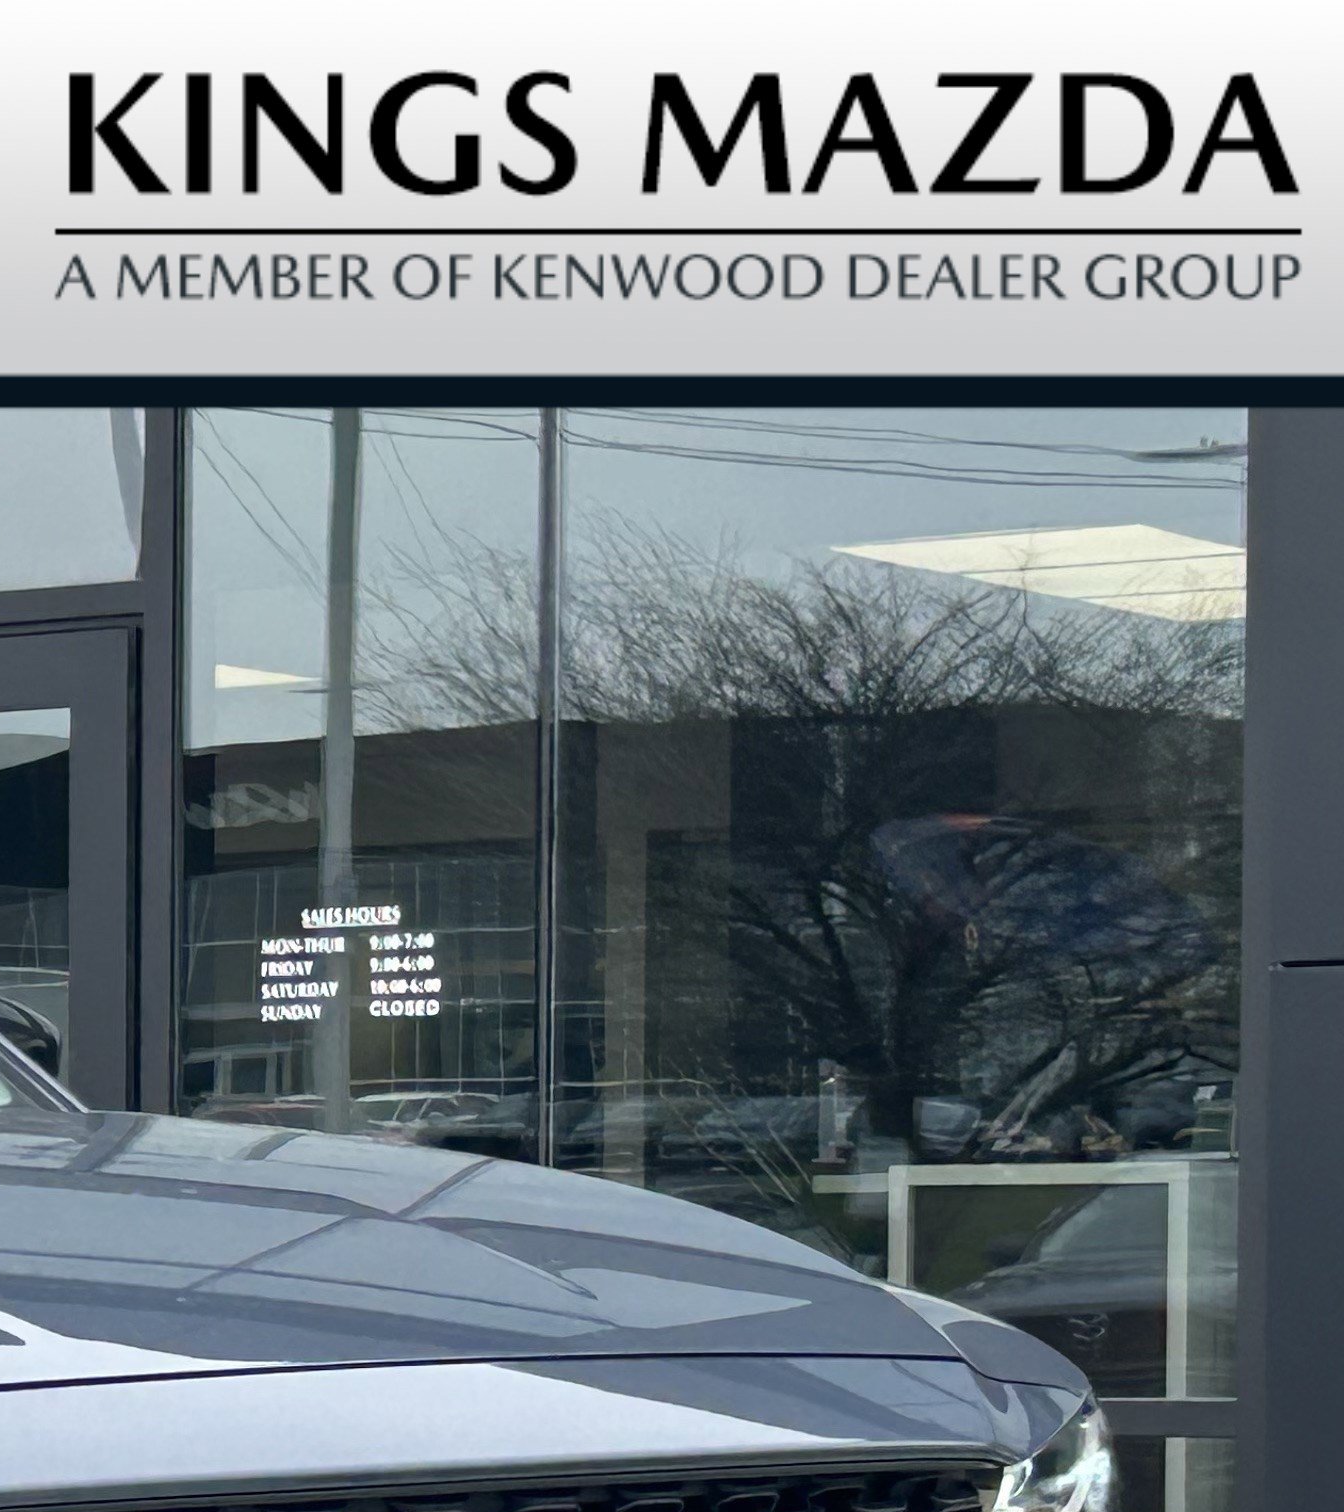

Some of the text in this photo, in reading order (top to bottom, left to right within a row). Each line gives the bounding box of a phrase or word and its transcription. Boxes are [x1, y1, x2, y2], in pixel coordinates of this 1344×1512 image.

[301, 905, 401, 927] SALES HOURS
[261, 961, 313, 977] FRIDAY
[261, 982, 339, 999] SATURDAY
[261, 999, 440, 1022] SUNDAY CLOSED
